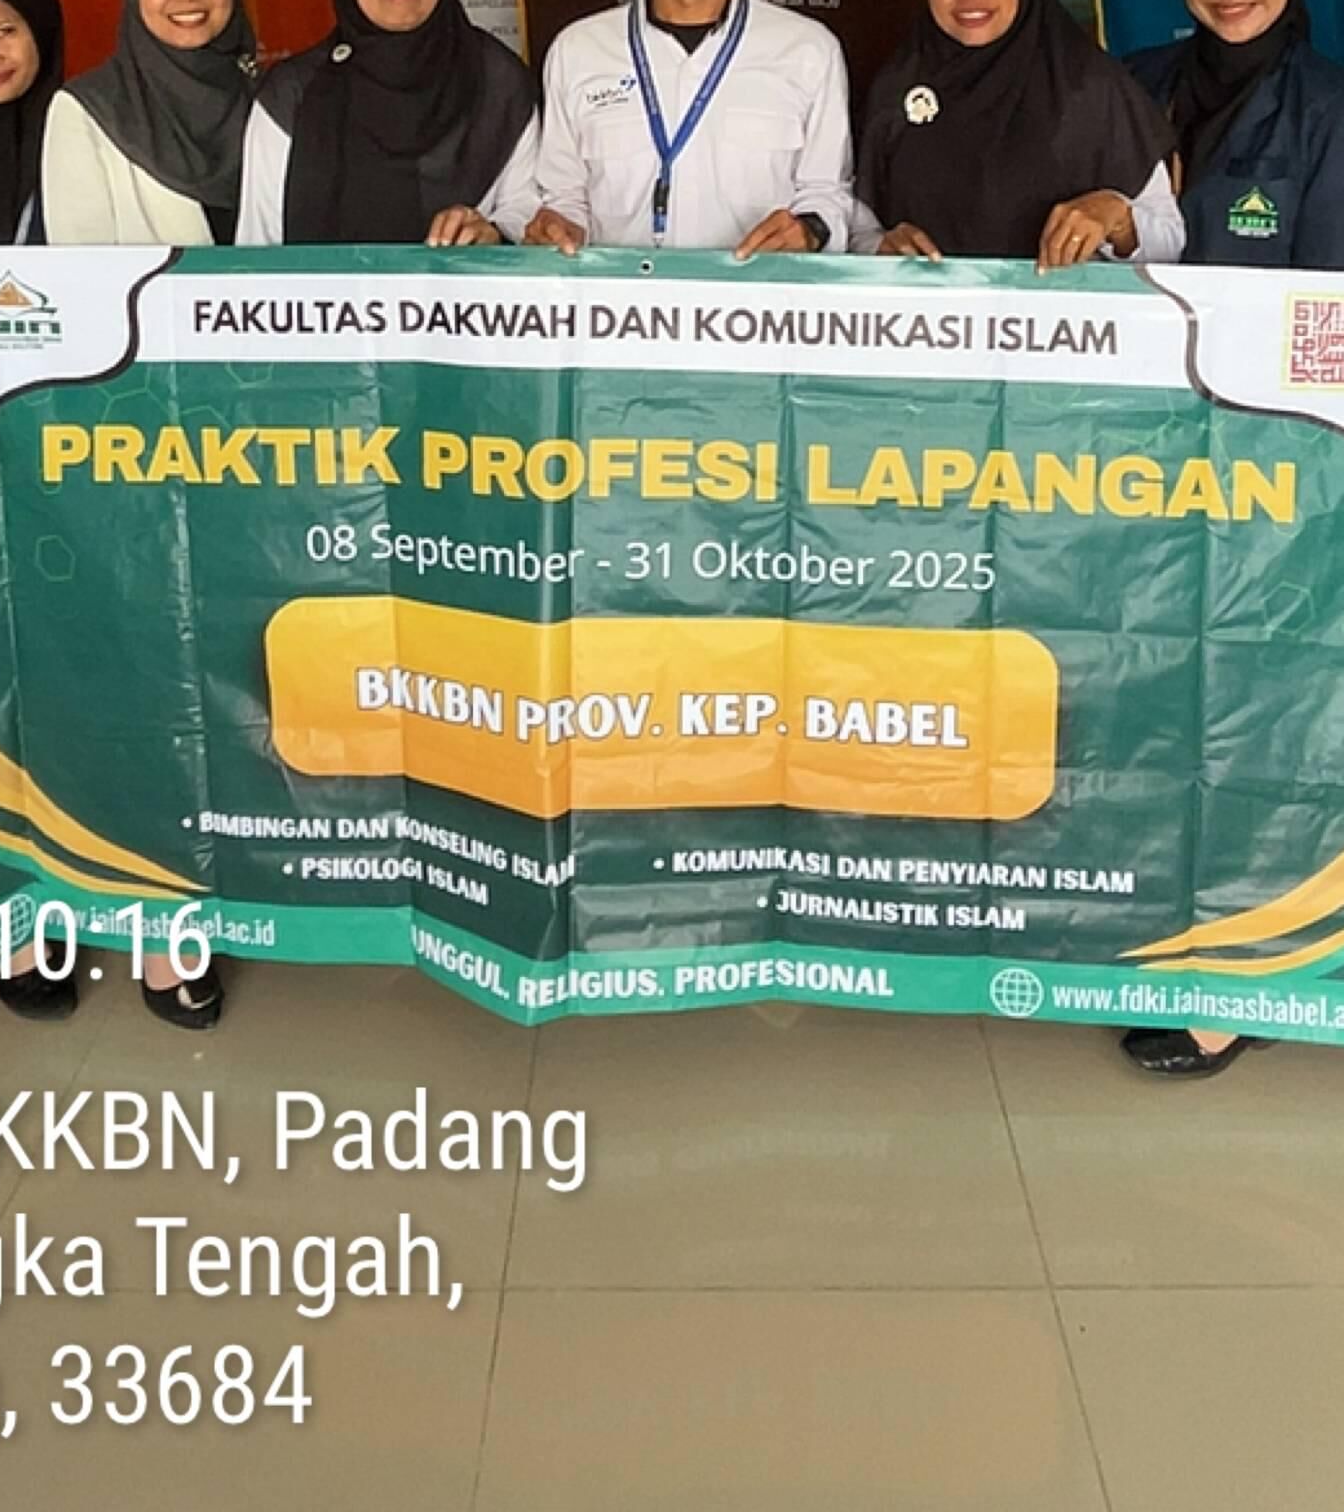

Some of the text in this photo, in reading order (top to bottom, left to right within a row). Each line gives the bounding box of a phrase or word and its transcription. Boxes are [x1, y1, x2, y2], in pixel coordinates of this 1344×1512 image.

[193, 298, 1119, 356] FAKULTAS DAKWAH DAN KOMUNIKASI ISLAM
[40, 424, 1298, 524] PRAKTIK PROFESI LAPANGAN
[305, 525, 358, 562] 08
[370, 522, 585, 585] September
[624, 541, 674, 580] 31
[692, 540, 876, 587] Oktober
[888, 549, 997, 591] 2025
[356, 665, 970, 749] BKKBN PROV. KEP. BABEL
[198, 810, 331, 842] BIMBINGAN
[336, 817, 390, 841] DAN
[394, 814, 509, 873] KONSELING
[671, 846, 1135, 895] KOMUNIKASI DAN PENYIARAN ISLAM
[300, 856, 489, 907] PSIKOLOGI ISLAM
[775, 889, 1027, 931] JURNALISTIK ISLAM
[673, 958, 895, 1000] PROFESIONAL
